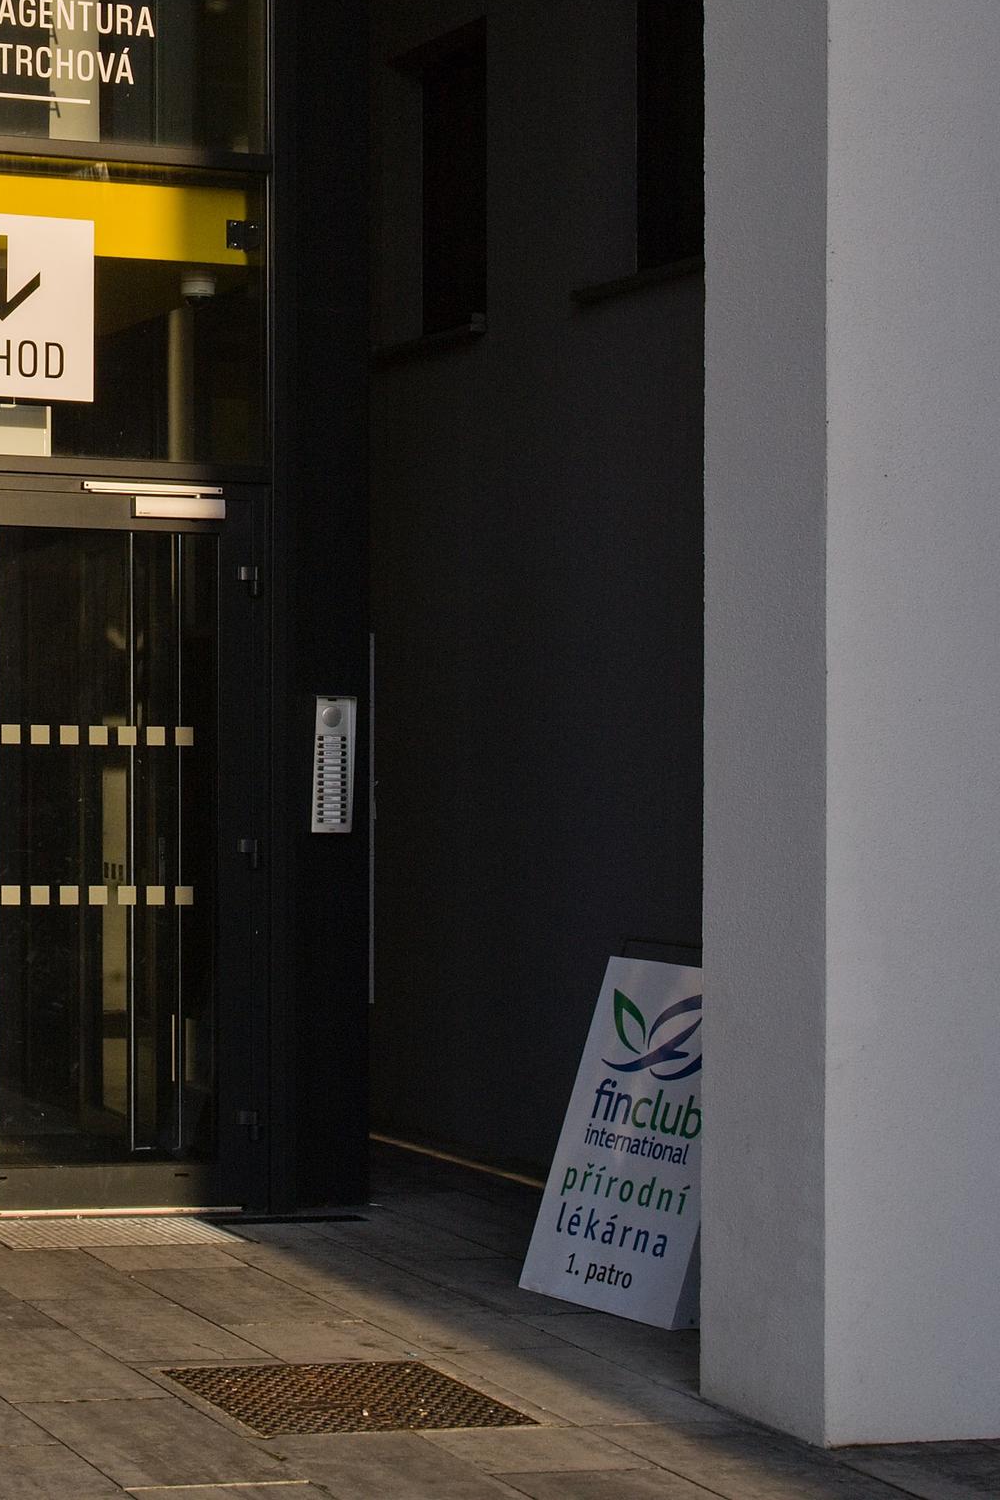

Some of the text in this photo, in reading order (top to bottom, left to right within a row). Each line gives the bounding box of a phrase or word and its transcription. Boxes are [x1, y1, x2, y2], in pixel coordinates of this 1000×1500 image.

[591, 1079, 702, 1140] finclub
[584, 1123, 689, 1166] international
[560, 1163, 692, 1216] přírodní
[555, 1202, 669, 1259] lékárna
[565, 1253, 633, 1290] 1. patro
